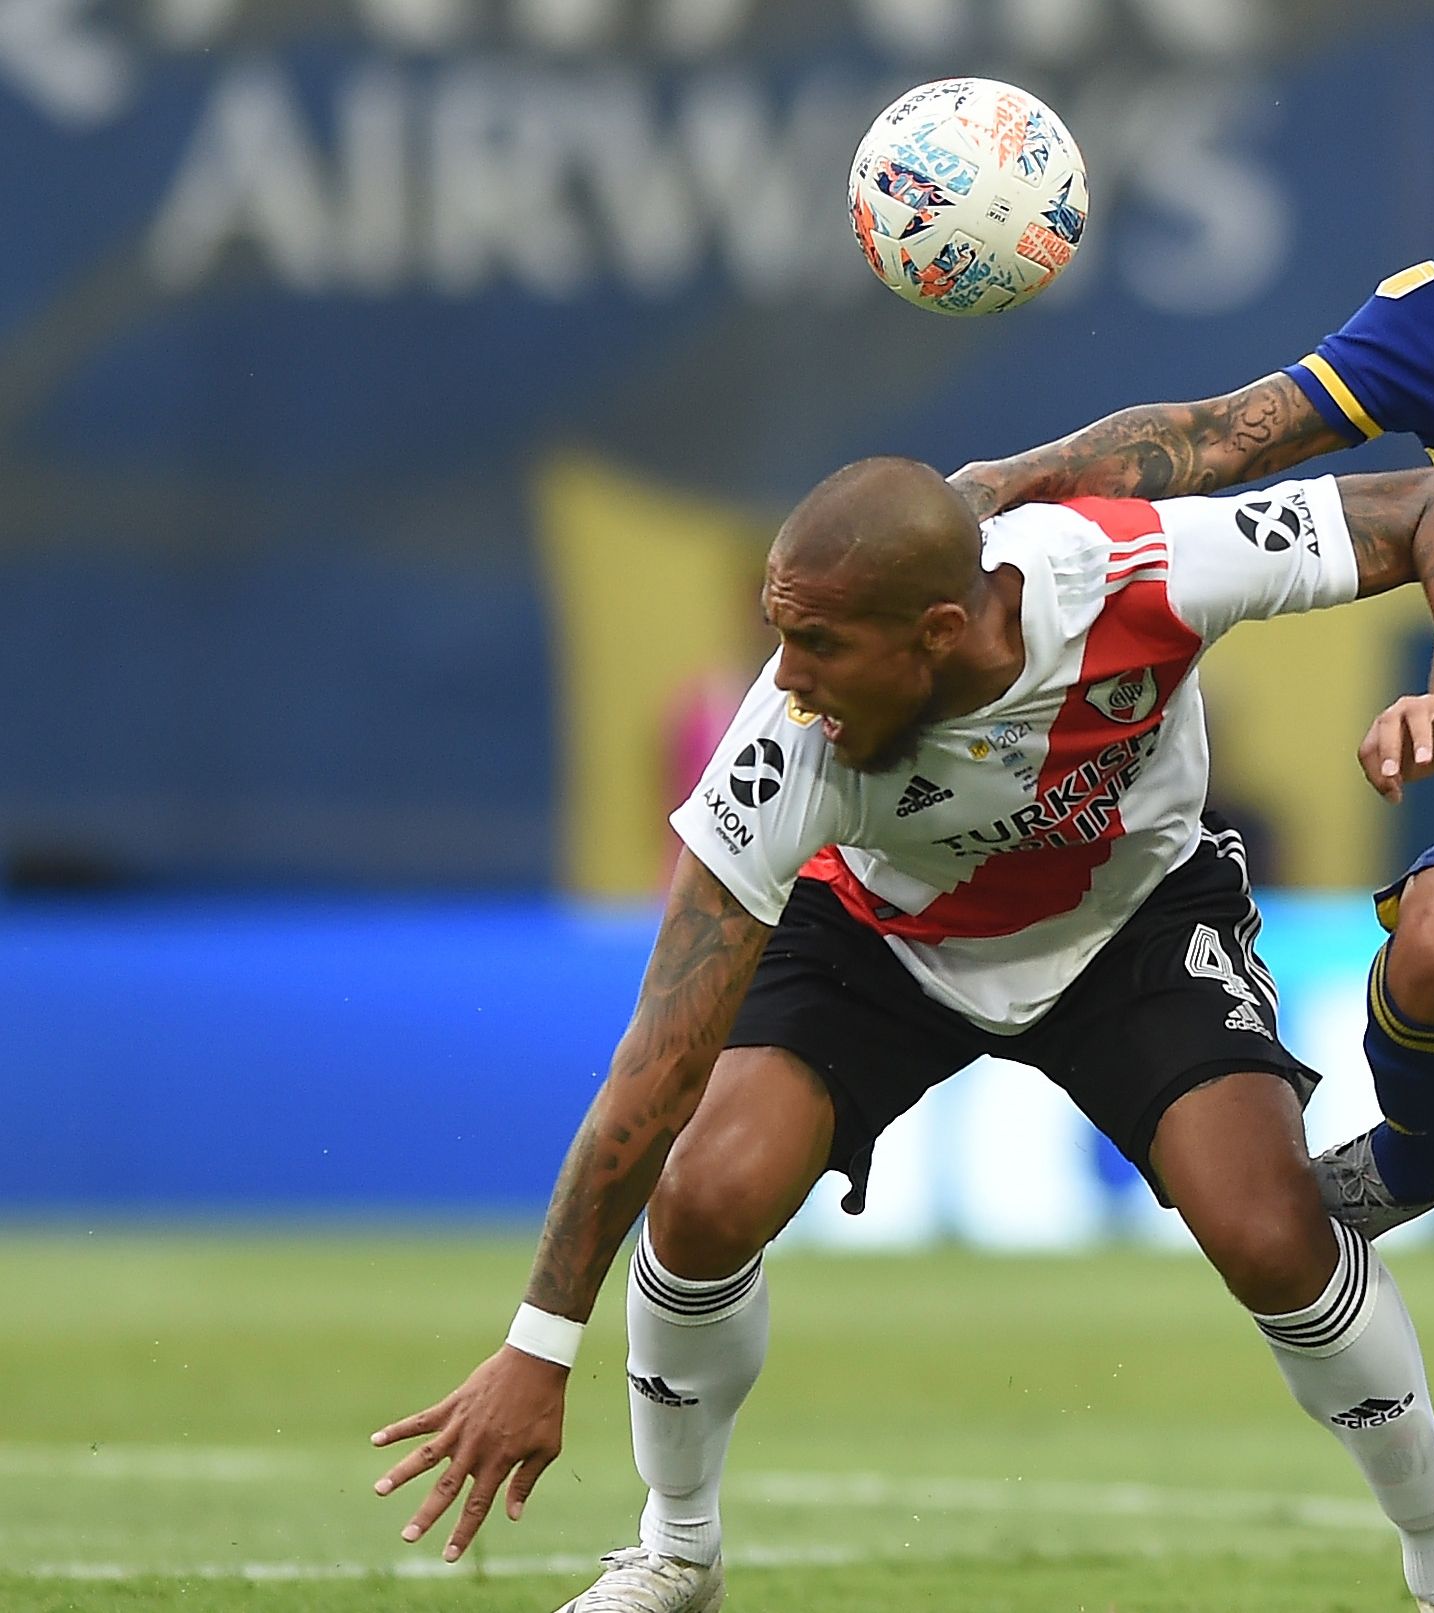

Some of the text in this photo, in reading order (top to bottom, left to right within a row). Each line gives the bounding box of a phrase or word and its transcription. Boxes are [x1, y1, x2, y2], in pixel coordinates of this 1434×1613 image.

[148, 55, 1288, 310] AIRWS
[996, 721, 1033, 750] 2021
[703, 786, 754, 848] AXION
[896, 788, 955, 818] adidas
[1184, 922, 1261, 1007] 4
[1330, 1391, 1415, 1430] adidas
